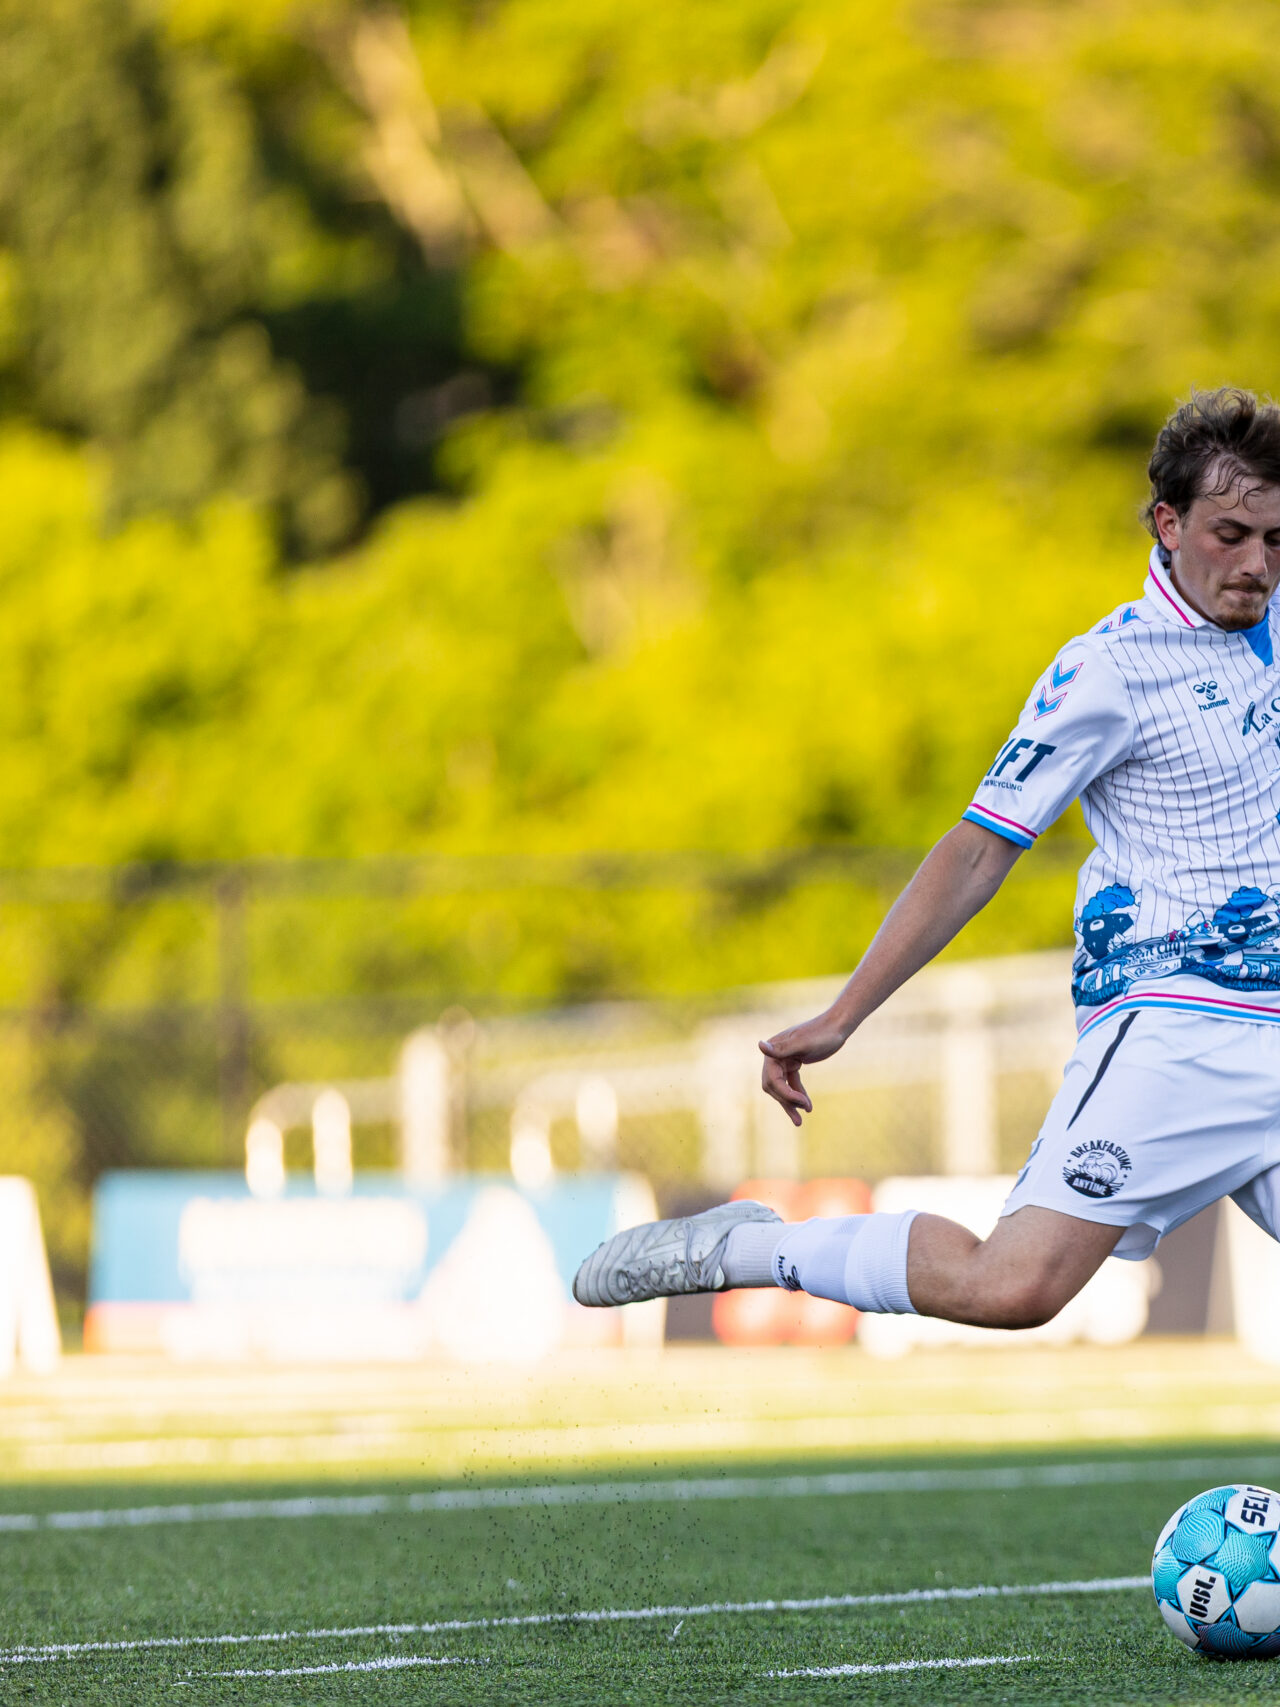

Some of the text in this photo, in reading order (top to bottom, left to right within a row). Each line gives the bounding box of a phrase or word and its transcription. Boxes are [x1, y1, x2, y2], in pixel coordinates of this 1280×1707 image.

[1198, 697, 1230, 711] hummel
[1246, 708, 1273, 734] La
[1072, 1177, 1107, 1196] ANYTIME
[1189, 1575, 1217, 1618] USL
